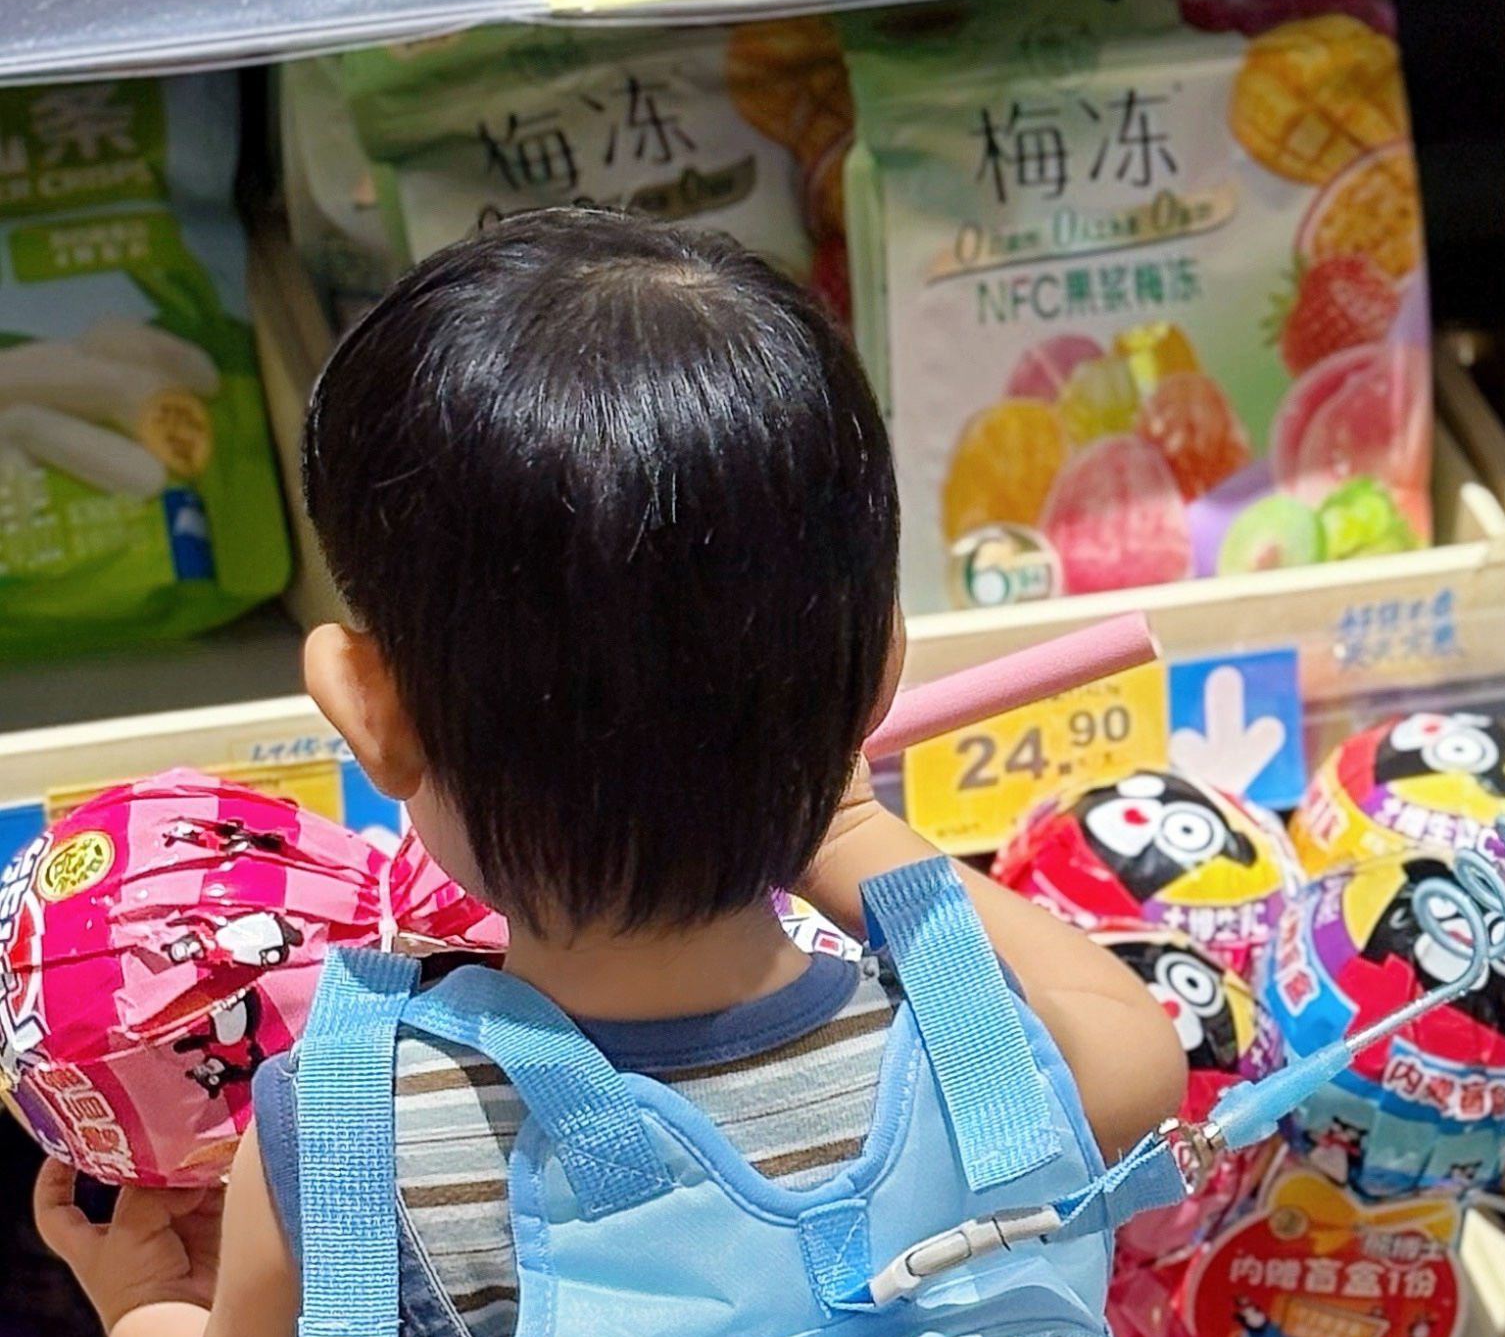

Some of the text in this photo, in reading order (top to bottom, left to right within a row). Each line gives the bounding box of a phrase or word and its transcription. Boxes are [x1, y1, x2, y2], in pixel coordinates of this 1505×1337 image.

[478, 76, 697, 193] 梅冻
[970, 86, 1178, 204] 梅冻
[955, 705, 1132, 792] 24.90
